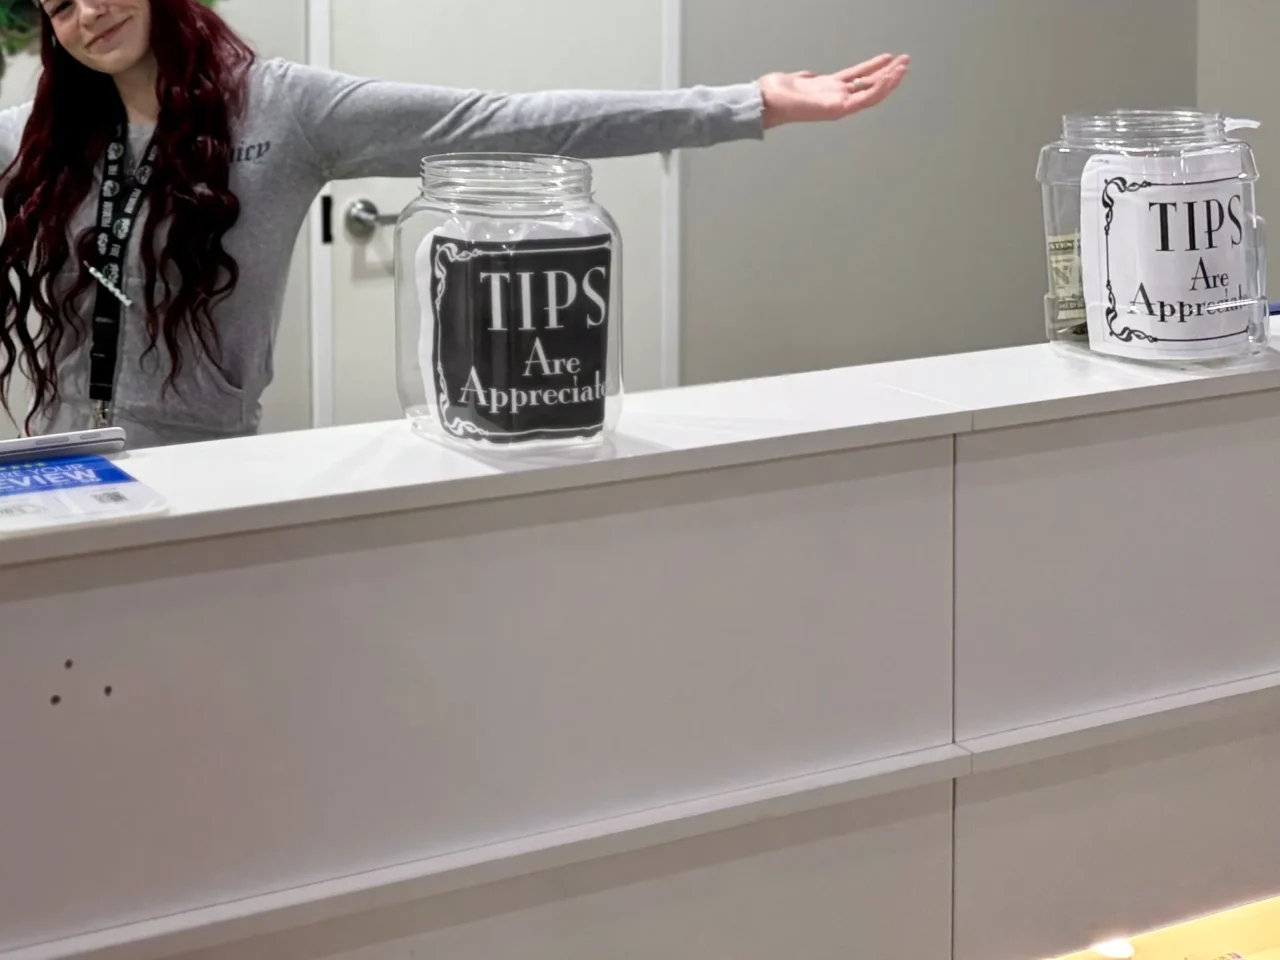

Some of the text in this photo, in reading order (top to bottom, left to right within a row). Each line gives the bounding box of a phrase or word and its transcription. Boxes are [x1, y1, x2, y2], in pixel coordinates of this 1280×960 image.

[1148, 194, 1243, 252] TIPS
[1189, 256, 1229, 291] Are
[479, 266, 606, 331] TIPS
[521, 336, 581, 376] Are
[24, 463, 85, 476] YOUR
